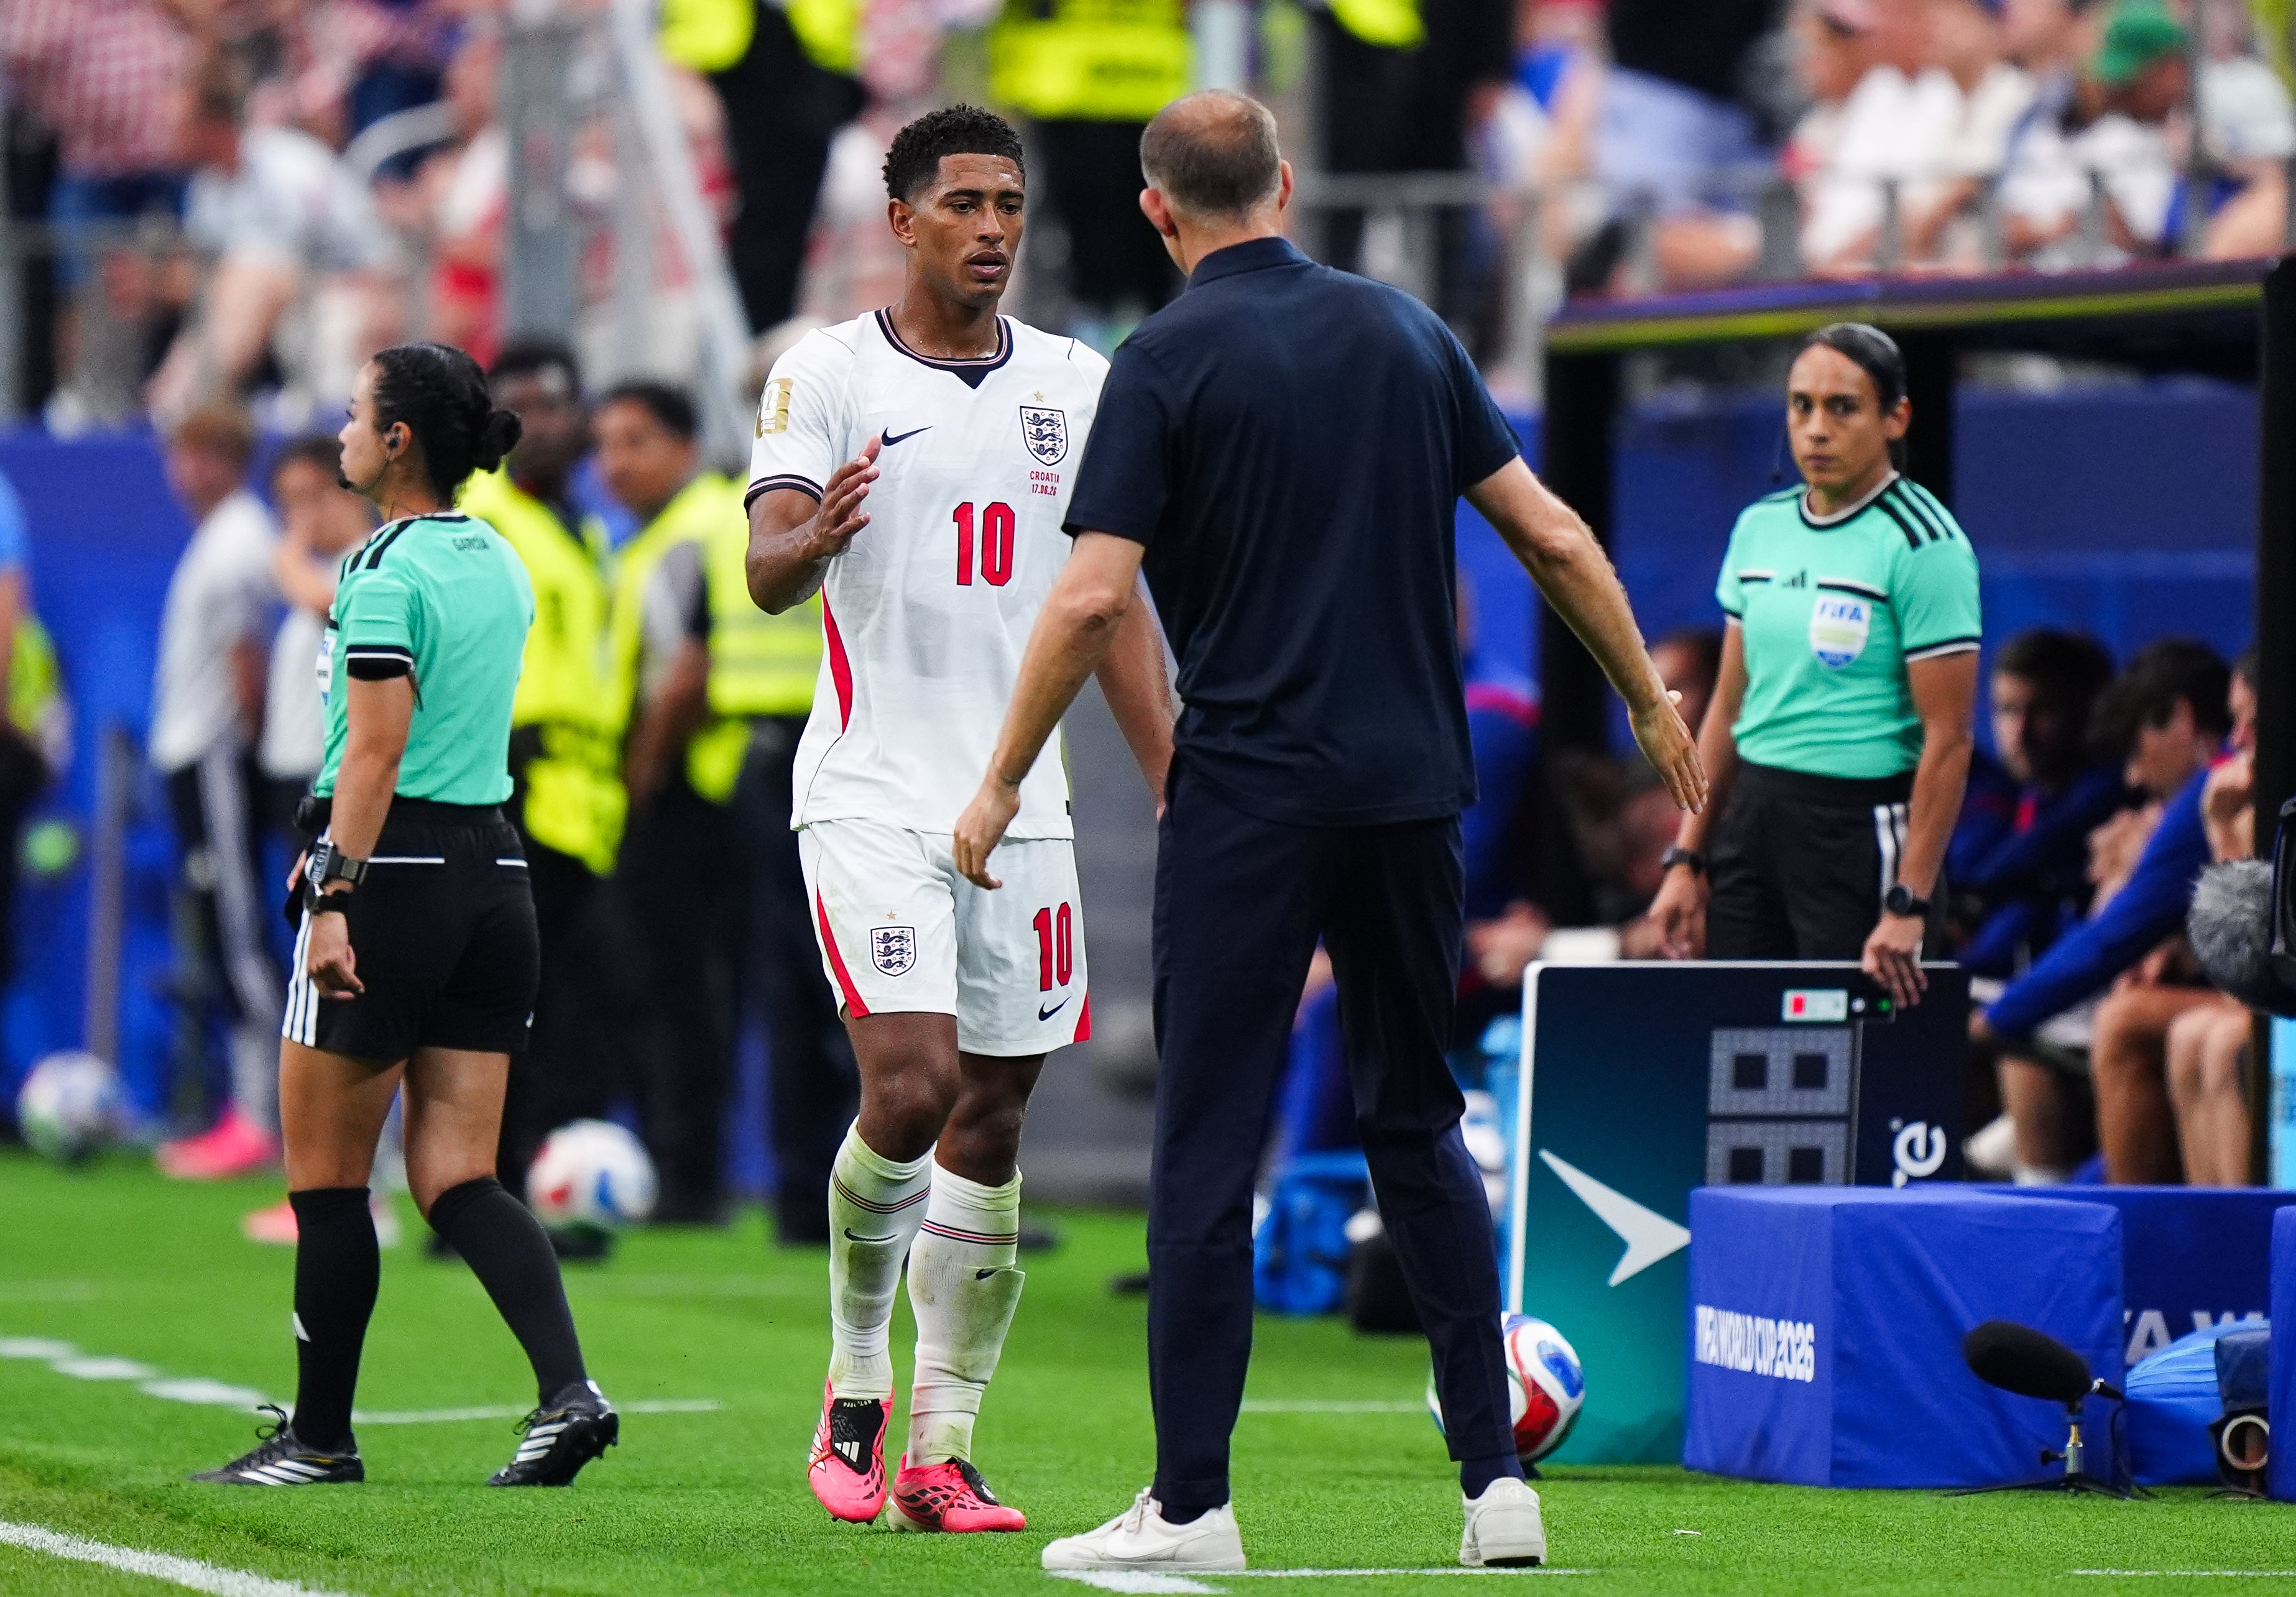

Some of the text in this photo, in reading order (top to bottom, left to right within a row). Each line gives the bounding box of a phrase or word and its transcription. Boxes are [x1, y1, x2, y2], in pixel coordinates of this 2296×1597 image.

[1030, 471, 1059, 484] CROATIA
[1032, 484, 1057, 496] 17.06.26
[953, 501, 1015, 587] 10
[1820, 601, 1862, 621] FIFA
[1033, 901, 1072, 992] 10
[1718, 1309, 1754, 1373] WORLD
[1754, 1315, 1778, 1376] CUP
[1773, 1320, 1815, 1383] 2026
[1491, 1486, 1523, 1500] NIKE
